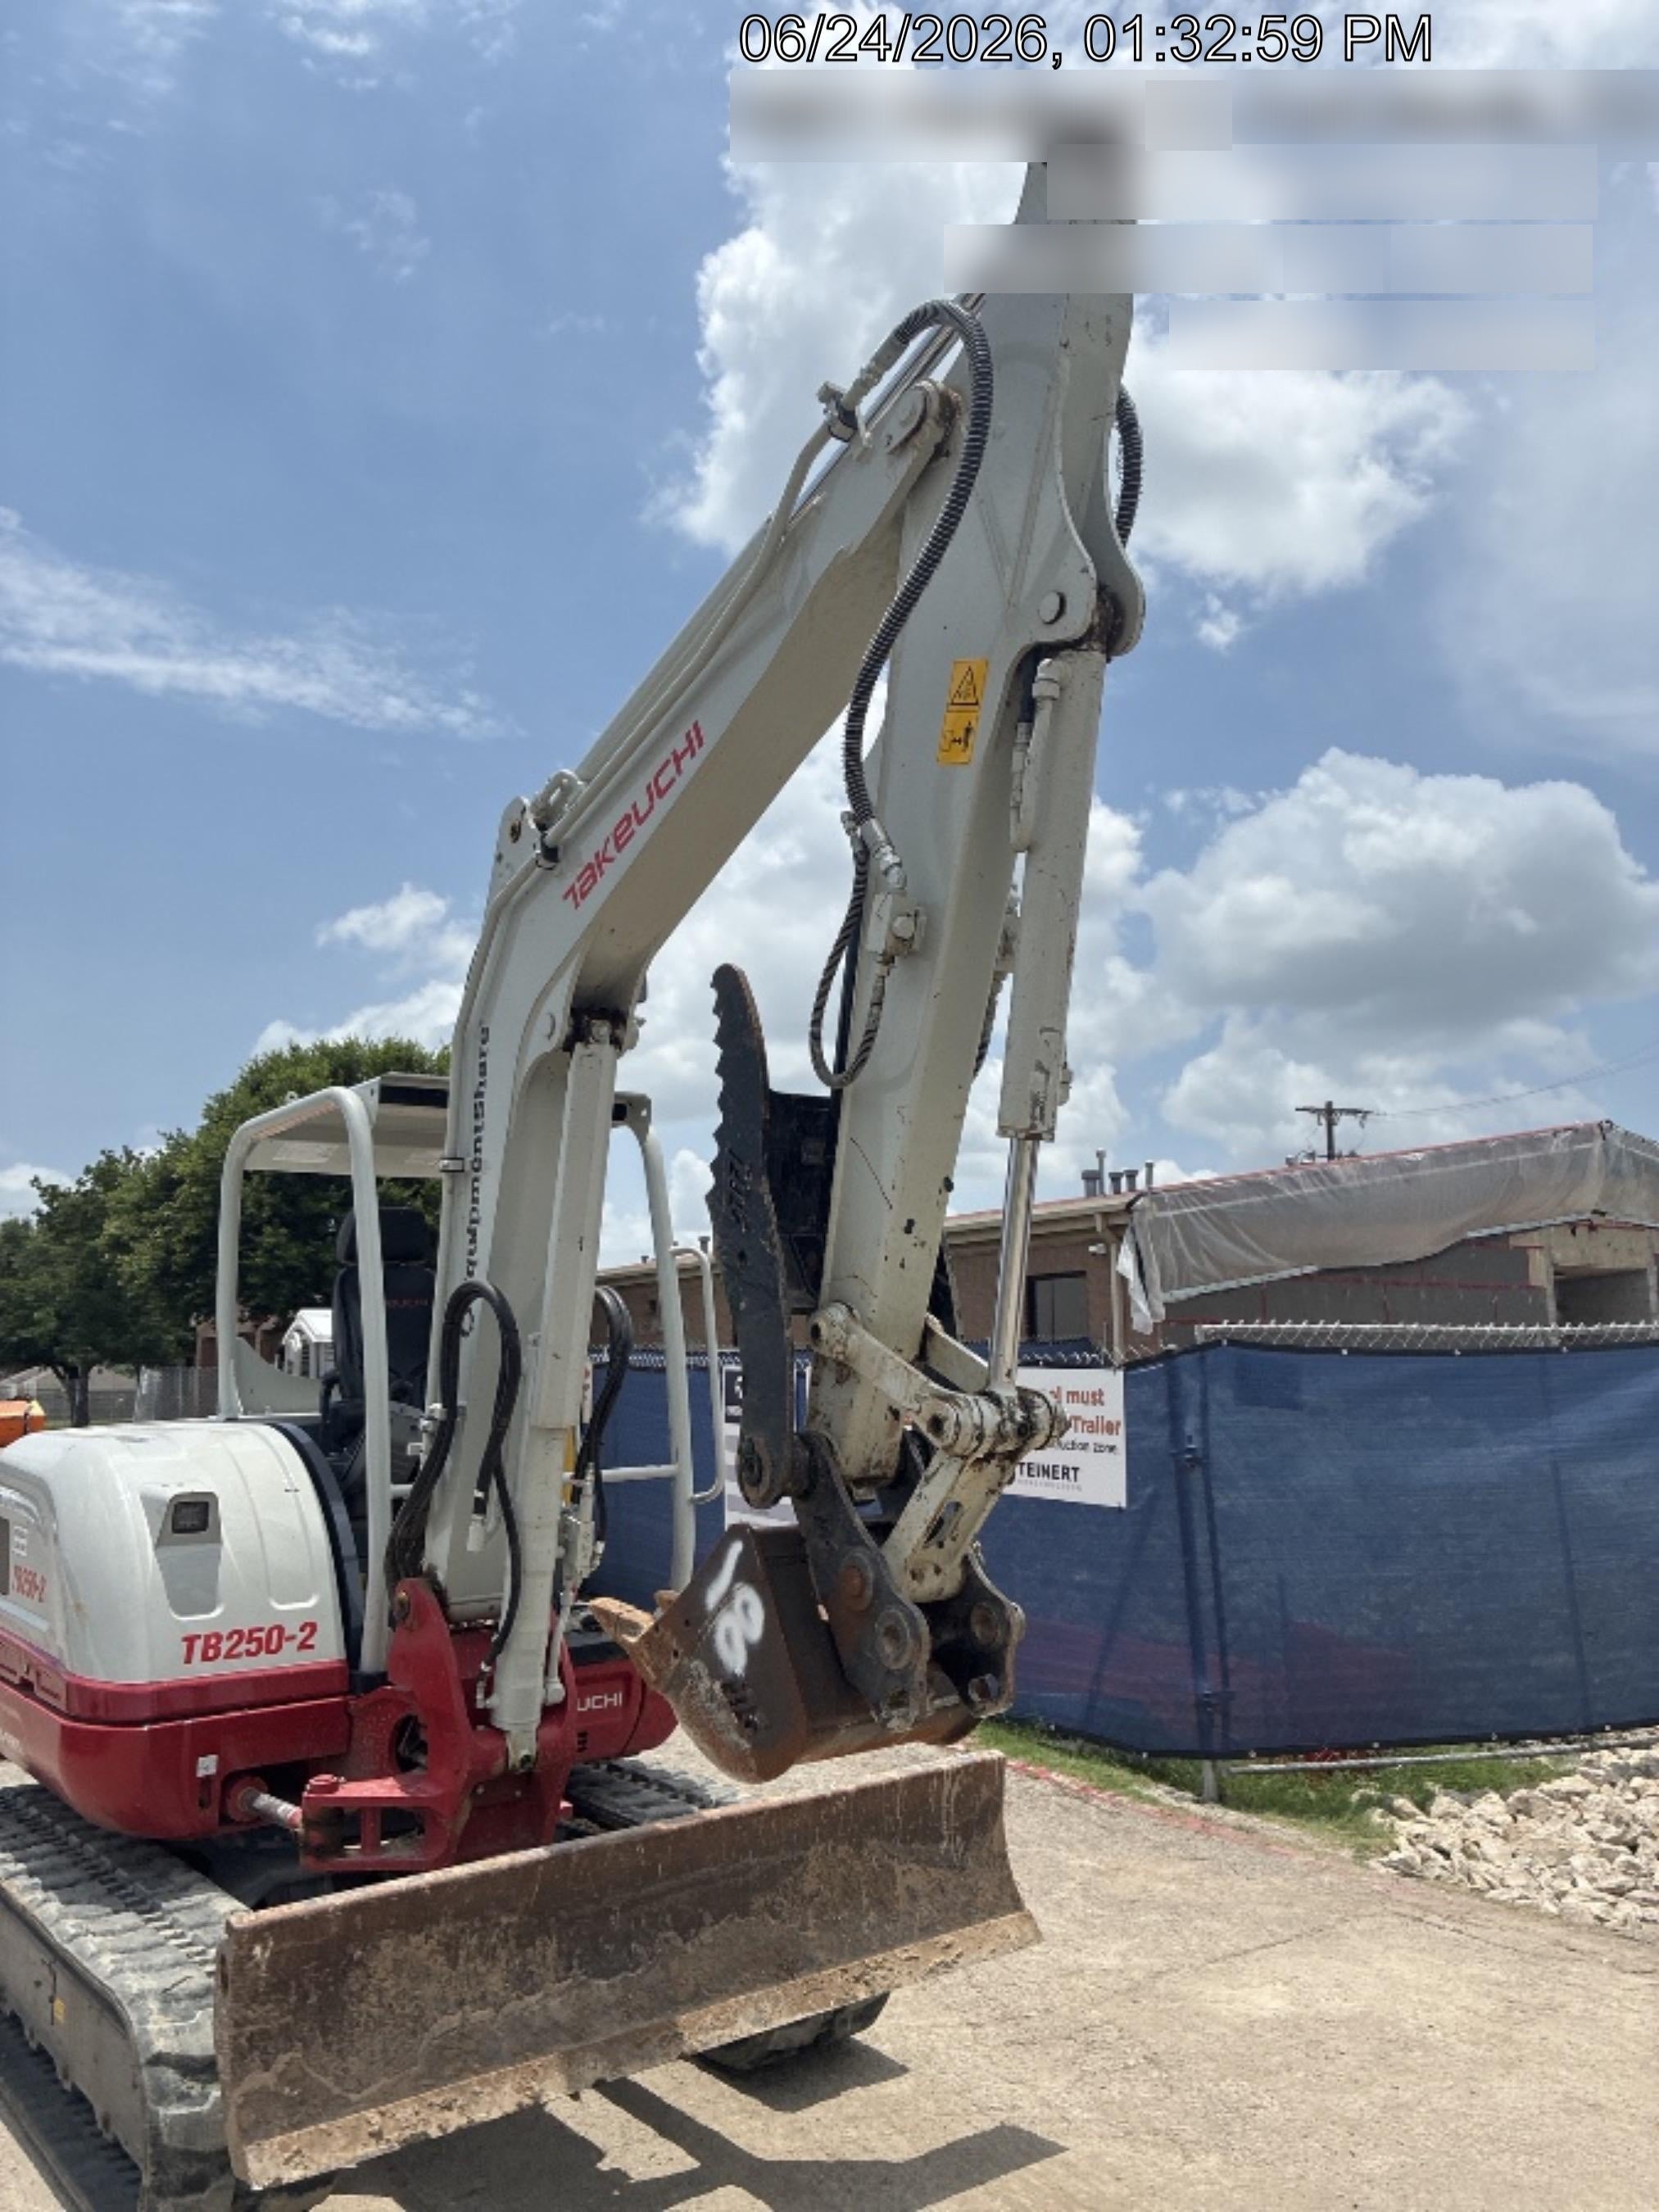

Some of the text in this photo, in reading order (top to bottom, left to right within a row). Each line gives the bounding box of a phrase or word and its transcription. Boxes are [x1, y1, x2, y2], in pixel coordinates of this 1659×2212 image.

[465, 1024, 491, 1280] quipmentShare
[1067, 1389, 1104, 1406] must
[1018, 1462, 1080, 1483] TEINERT
[181, 1621, 318, 1665] TB250-2
[577, 1691, 623, 1712] UCHI
